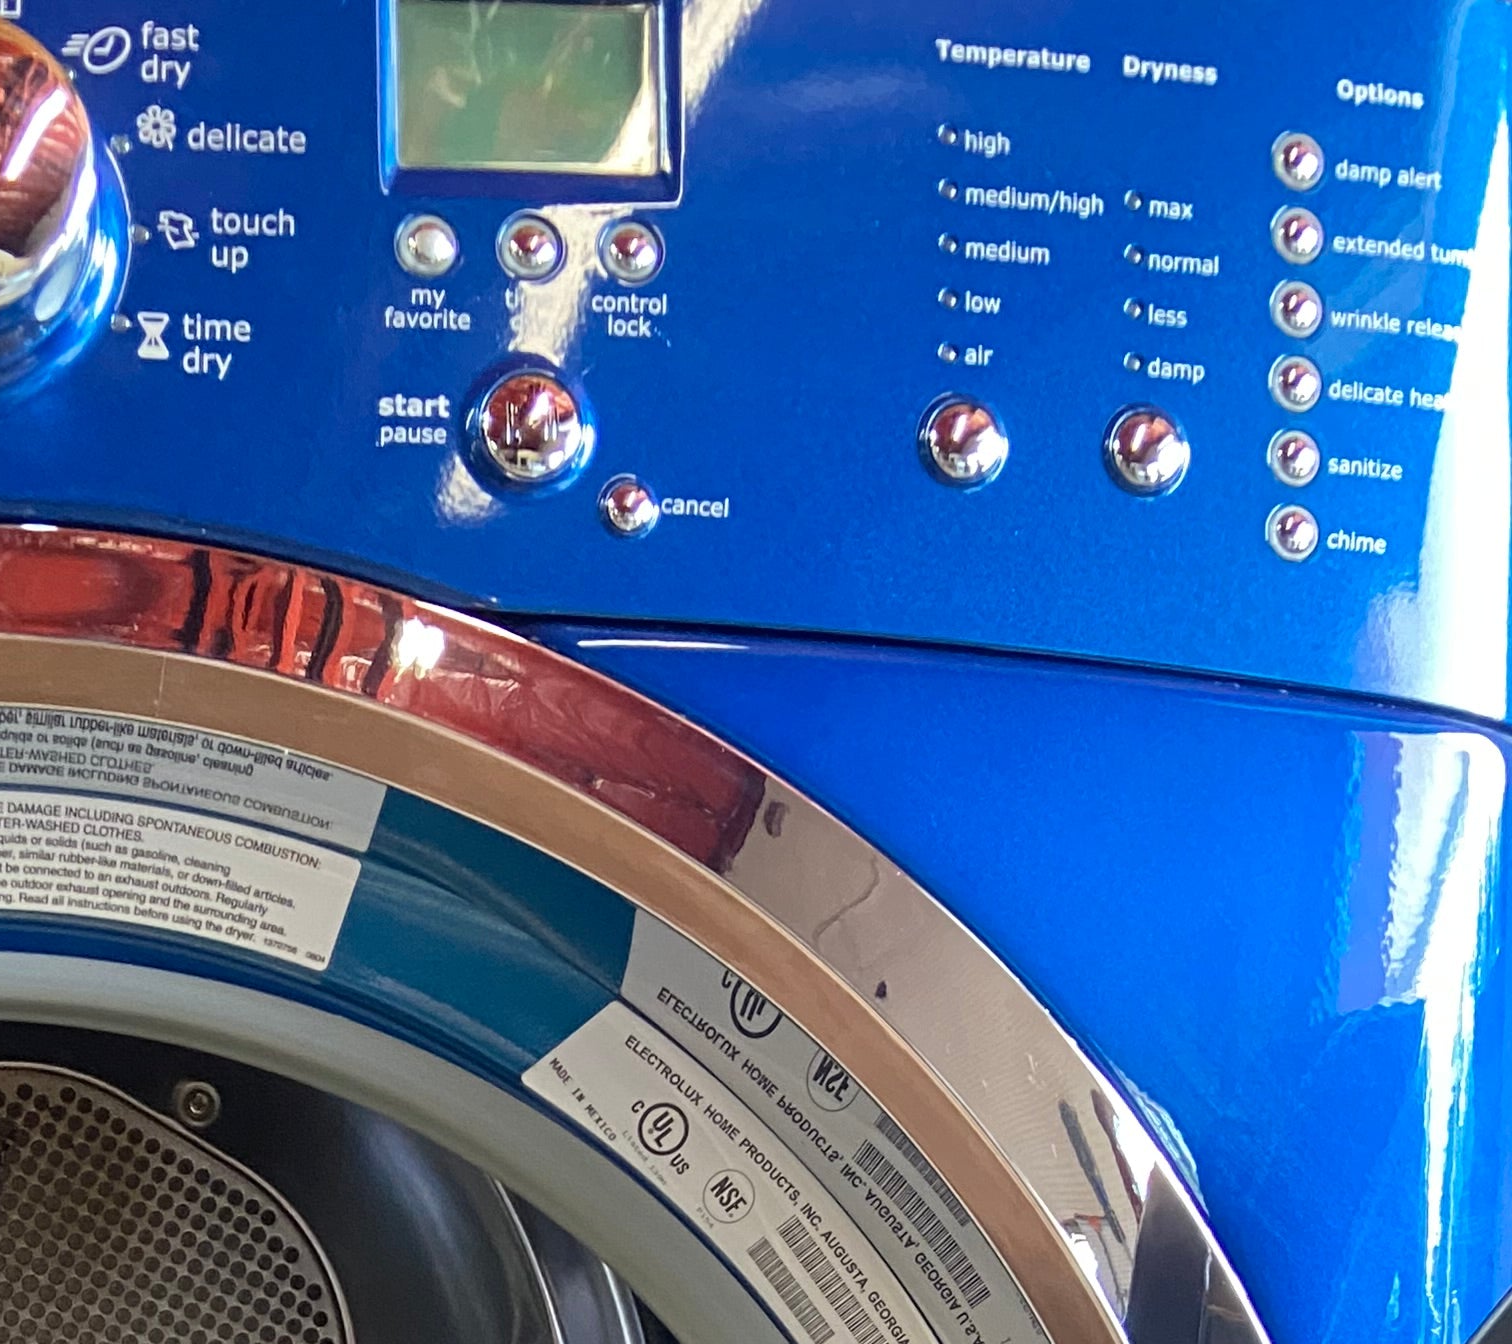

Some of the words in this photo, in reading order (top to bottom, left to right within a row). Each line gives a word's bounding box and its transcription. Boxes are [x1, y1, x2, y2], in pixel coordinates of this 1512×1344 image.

[141, 22, 199, 51] fast
[935, 38, 1090, 74] Temperature
[141, 54, 190, 88] dry
[1123, 55, 1218, 86] Dryness
[1337, 79, 1424, 110] Options
[187, 123, 307, 153] delicate
[964, 129, 1011, 156] high
[1335, 159, 1391, 188] damp
[1397, 167, 1442, 191] alert
[965, 186, 1104, 217] medium/high
[1148, 197, 1194, 222] max
[211, 209, 296, 238] touch
[211, 244, 249, 270] up
[965, 239, 1050, 266] medium
[1147, 252, 1220, 277] normal
[1333, 235, 1425, 260] extended
[1431, 243, 1475, 267] tum
[411, 287, 446, 309] my
[591, 293, 668, 315] control
[965, 291, 1001, 314] low
[183, 316, 252, 342] time
[384, 307, 472, 330] favorite
[607, 315, 651, 338] lock
[1147, 303, 1187, 328] less
[1331, 309, 1400, 334] wrinkle
[182, 347, 233, 379] dry
[964, 344, 994, 366] air
[1147, 357, 1205, 384] damp
[1328, 379, 1403, 405] delicate
[378, 395, 451, 419] start
[379, 424, 447, 446] pause
[1328, 456, 1403, 481] sanitize
[661, 497, 729, 518] cancel
[1327, 530, 1386, 555] chime
[7, 803, 61, 816] DAMAGE
[65, 807, 134, 825] INCLUDING
[137, 815, 232, 845] SPONTANEOUS
[235, 835, 322, 870] COMBUSTION:
[83, 824, 144, 842] CLOTHES.
[31, 837, 42, 845] or
[45, 836, 77, 848] solids
[81, 838, 111, 851] (such
[115, 844, 128, 854] as
[131, 846, 180, 865] gasoline,
[184, 856, 231, 876] cleaning
[550, 1058, 572, 1085] MADE
[572, 1088, 587, 1103] IN
[585, 1104, 616, 1142] MEXICO
[652, 1111, 674, 1148] UL
[670, 1154, 689, 1175] US
[625, 1035, 704, 1107] ELECTROLUX
[703, 1103, 740, 1141] HOME
[739, 1138, 800, 1206] PRODUCTS,
[800, 1202, 823, 1231] INC.
[821, 1229, 869, 1294] AUGUSTA,
[710, 1176, 747, 1213] NSF
